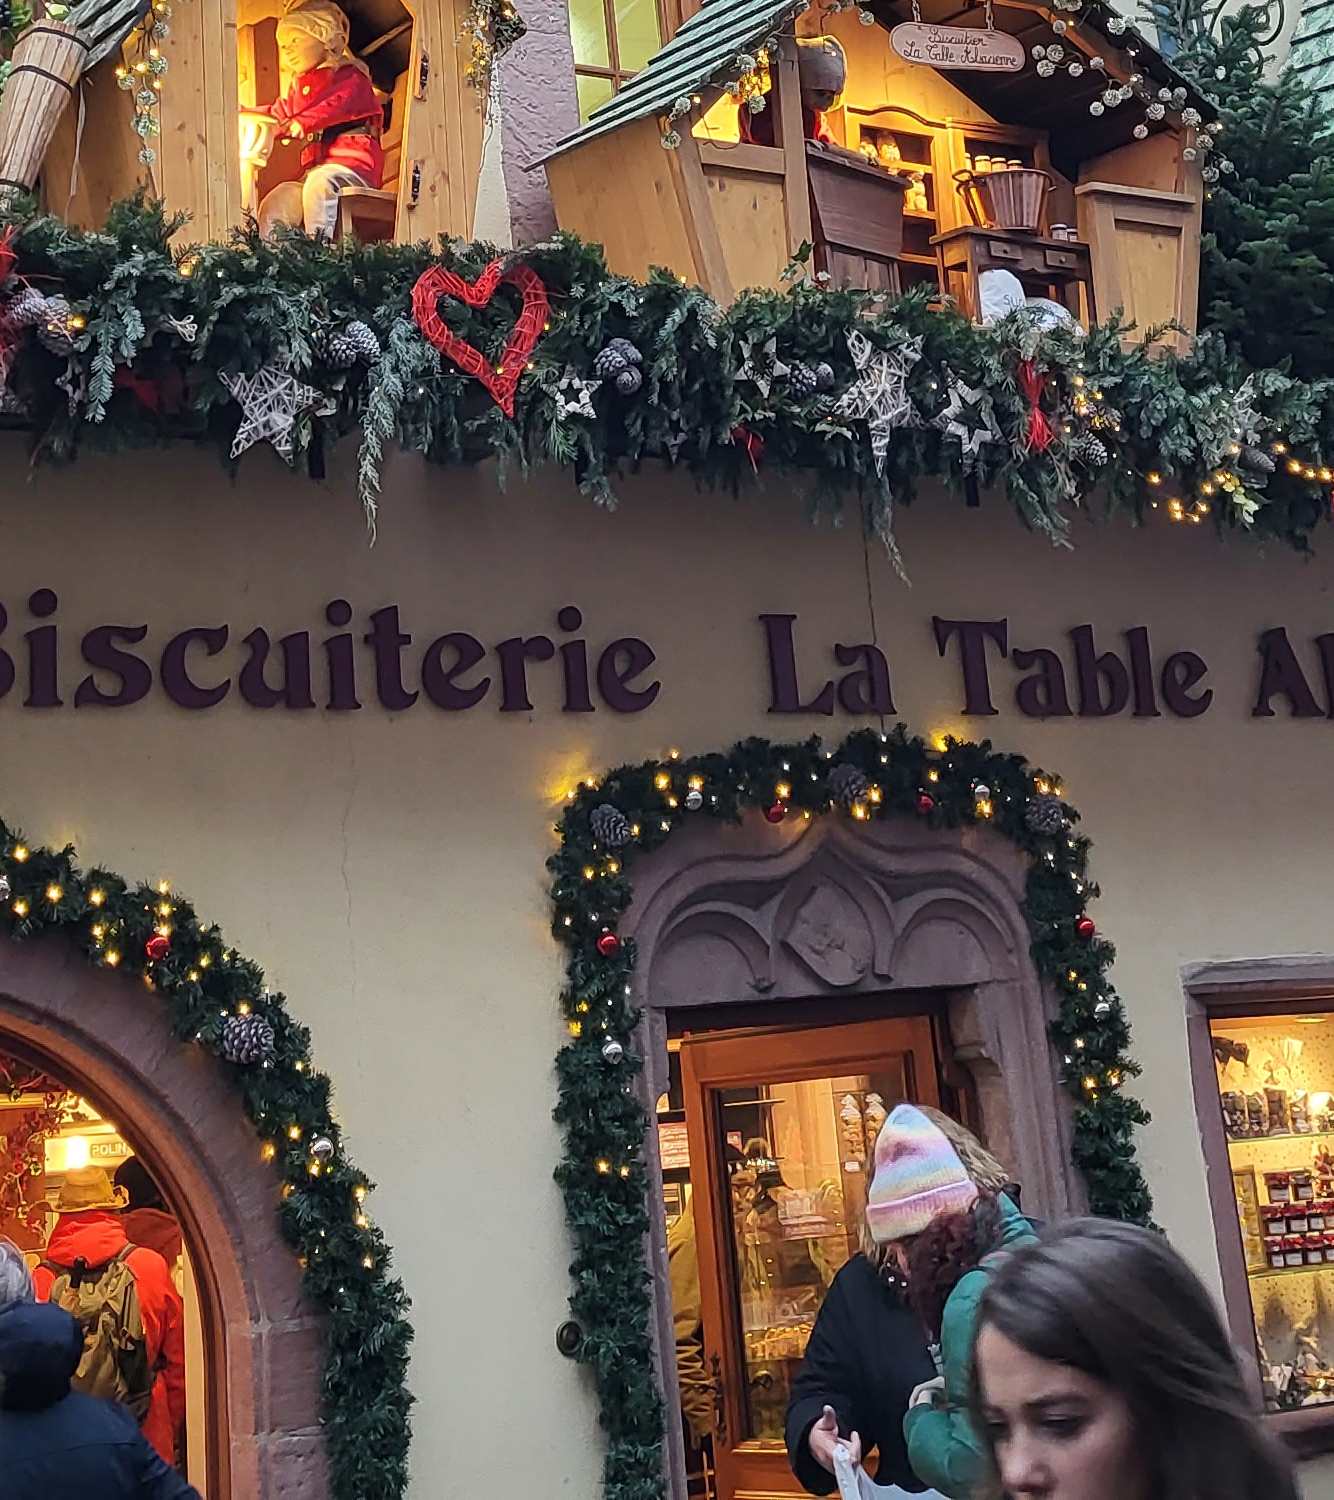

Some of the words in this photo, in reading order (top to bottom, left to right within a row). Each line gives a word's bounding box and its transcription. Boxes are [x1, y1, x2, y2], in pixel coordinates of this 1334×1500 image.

[928, 26, 988, 47] Biscuitier
[903, 40, 924, 59] La
[925, 44, 956, 63] Table
[960, 49, 1018, 67] Alsacienne
[757, 613, 897, 717] La
[931, 617, 1214, 719] Table
[92, 1142, 127, 1156] POLIN
